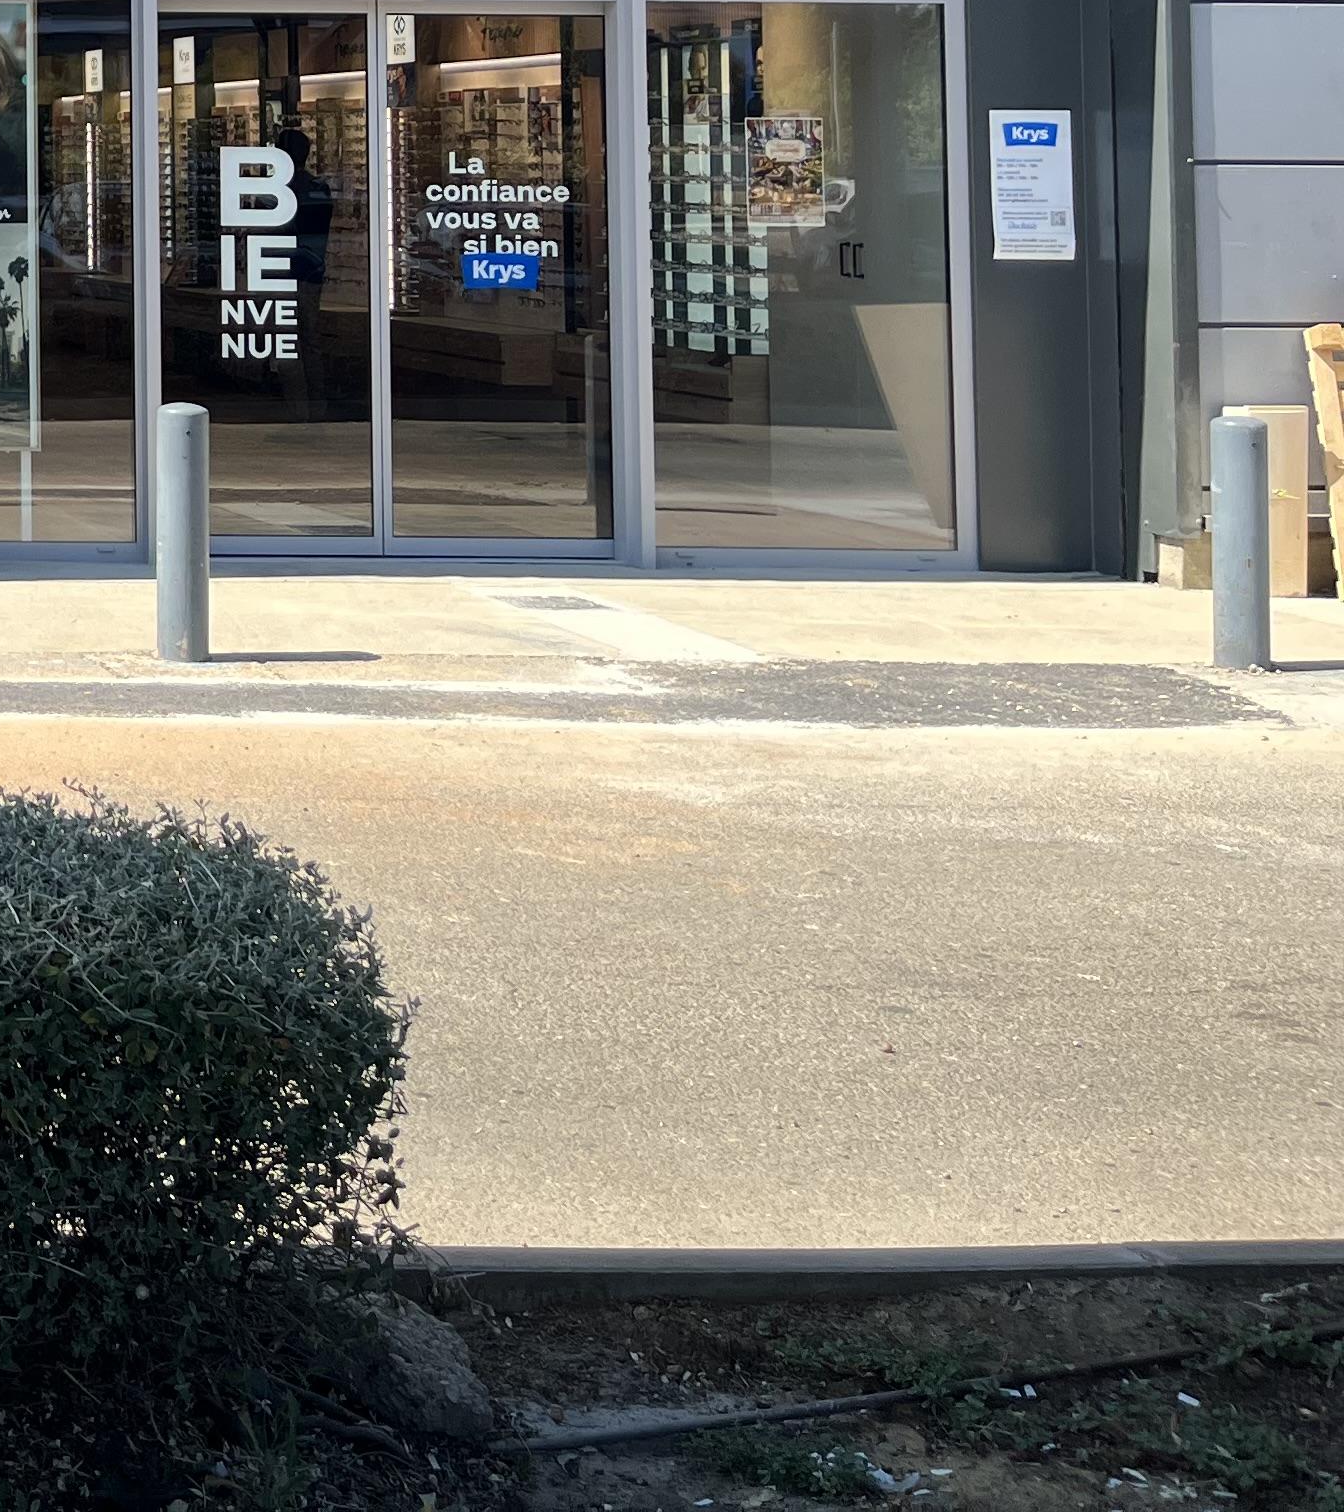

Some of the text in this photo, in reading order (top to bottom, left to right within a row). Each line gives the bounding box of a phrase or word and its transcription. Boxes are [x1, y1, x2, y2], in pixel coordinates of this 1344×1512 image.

[1012, 126, 1049, 142] Krys
[449, 152, 485, 175] La
[220, 146, 298, 226] B
[425, 180, 570, 202] confiance
[426, 212, 540, 230] vous va
[463, 235, 559, 257] si bien
[220, 235, 298, 291] IE
[472, 260, 526, 284] Krys
[221, 300, 298, 325] NVE
[221, 333, 298, 359] NUE
